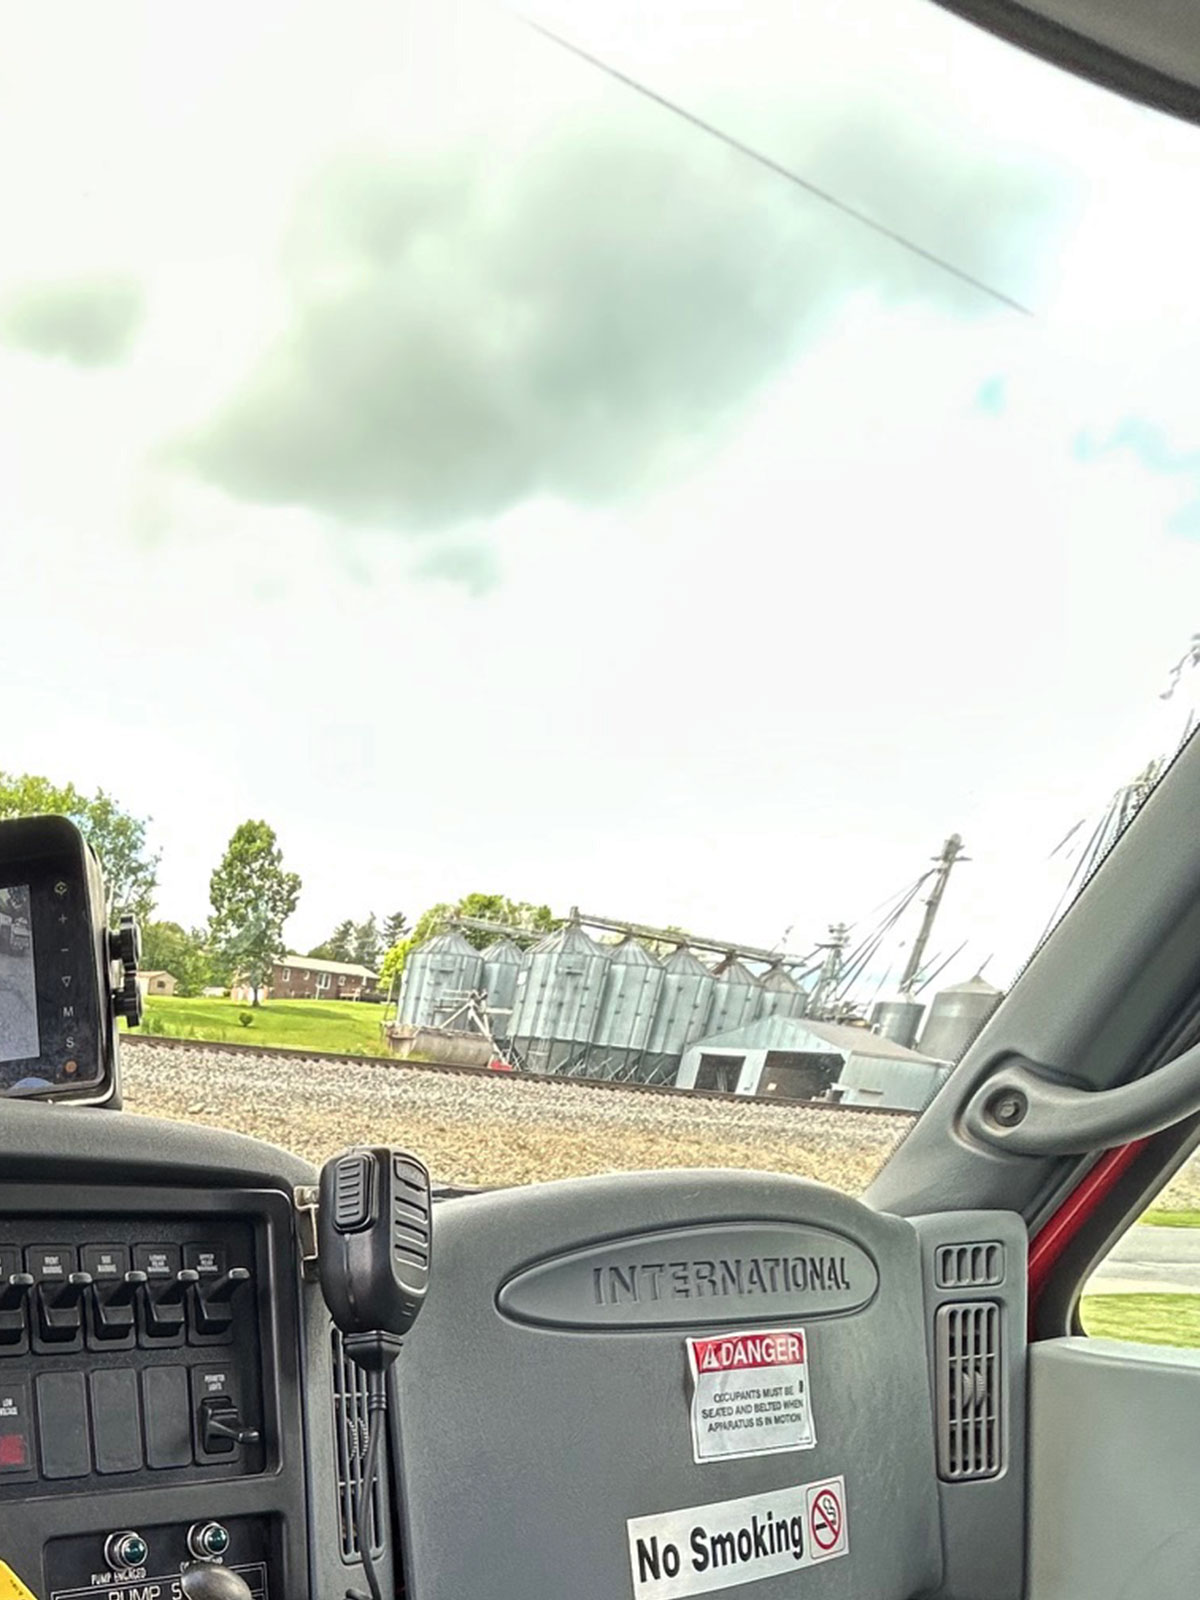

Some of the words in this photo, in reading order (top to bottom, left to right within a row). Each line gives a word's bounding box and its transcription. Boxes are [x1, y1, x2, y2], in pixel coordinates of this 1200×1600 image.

[66, 1036, 75, 1048] S
[593, 1257, 852, 1305] INTERNATIONAL
[721, 1338, 802, 1367] DANGER
[713, 1389, 761, 1403] OCCUPANTS
[762, 1386, 783, 1397] MUST
[784, 1385, 795, 1396] BE
[701, 1406, 734, 1420] SEATED
[735, 1404, 753, 1415] AND
[753, 1401, 782, 1413] BELTED
[783, 1399, 804, 1410] WHEN
[707, 1419, 755, 1433] APPARATUS
[755, 1417, 764, 1428] IS
[764, 1416, 773, 1426] IN
[774, 1413, 802, 1424] MOTION
[637, 1536, 681, 1583] No
[690, 1511, 805, 1572] Smoking
[91, 1572, 112, 1585] PUMP
